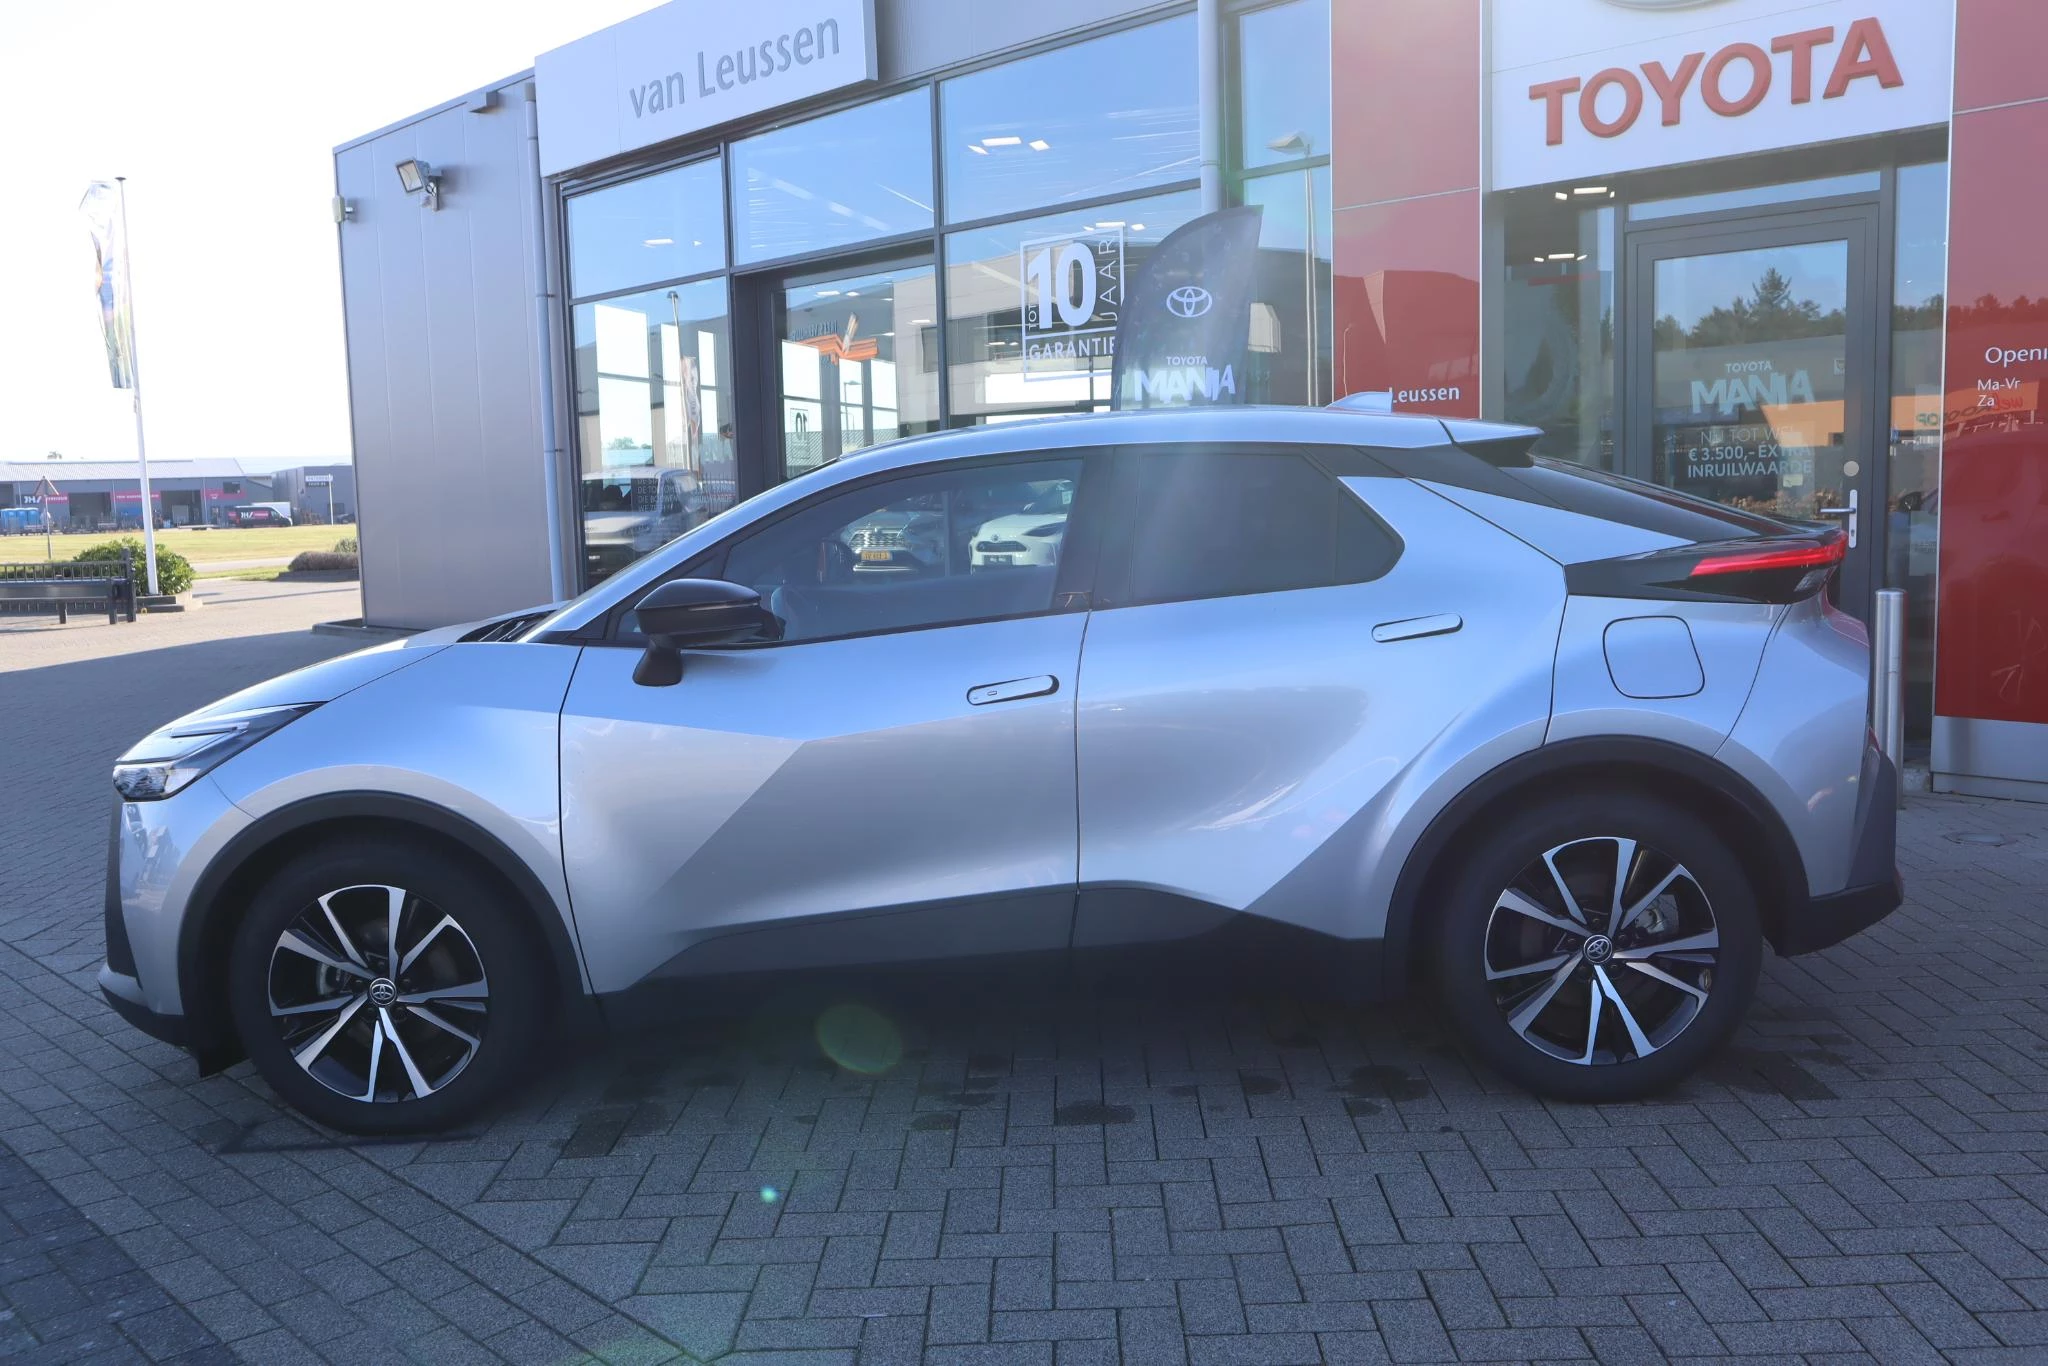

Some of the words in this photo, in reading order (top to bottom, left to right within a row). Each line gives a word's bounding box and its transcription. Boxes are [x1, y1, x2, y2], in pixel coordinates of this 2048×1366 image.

[629, 71, 685, 119] van
[697, 18, 840, 98] Leussen
[1529, 16, 1904, 146] TOYOTA
[1027, 242, 1097, 330] 10
[1098, 238, 1118, 322] JAAR
[1166, 356, 1208, 367] TOYOTA
[1726, 360, 1773, 373] TOYOTA
[1133, 363, 1235, 402] MANIA
[1977, 376, 2021, 392] Ma-Vr
[1690, 369, 1817, 416] MANIA
[1976, 394, 1996, 407] Za
[1728, 427, 1760, 442] TOT
[1688, 448, 1698, 462] €
[1701, 445, 1755, 462] 3.500,-
[1687, 460, 1813, 478] INRUILWAARDE
